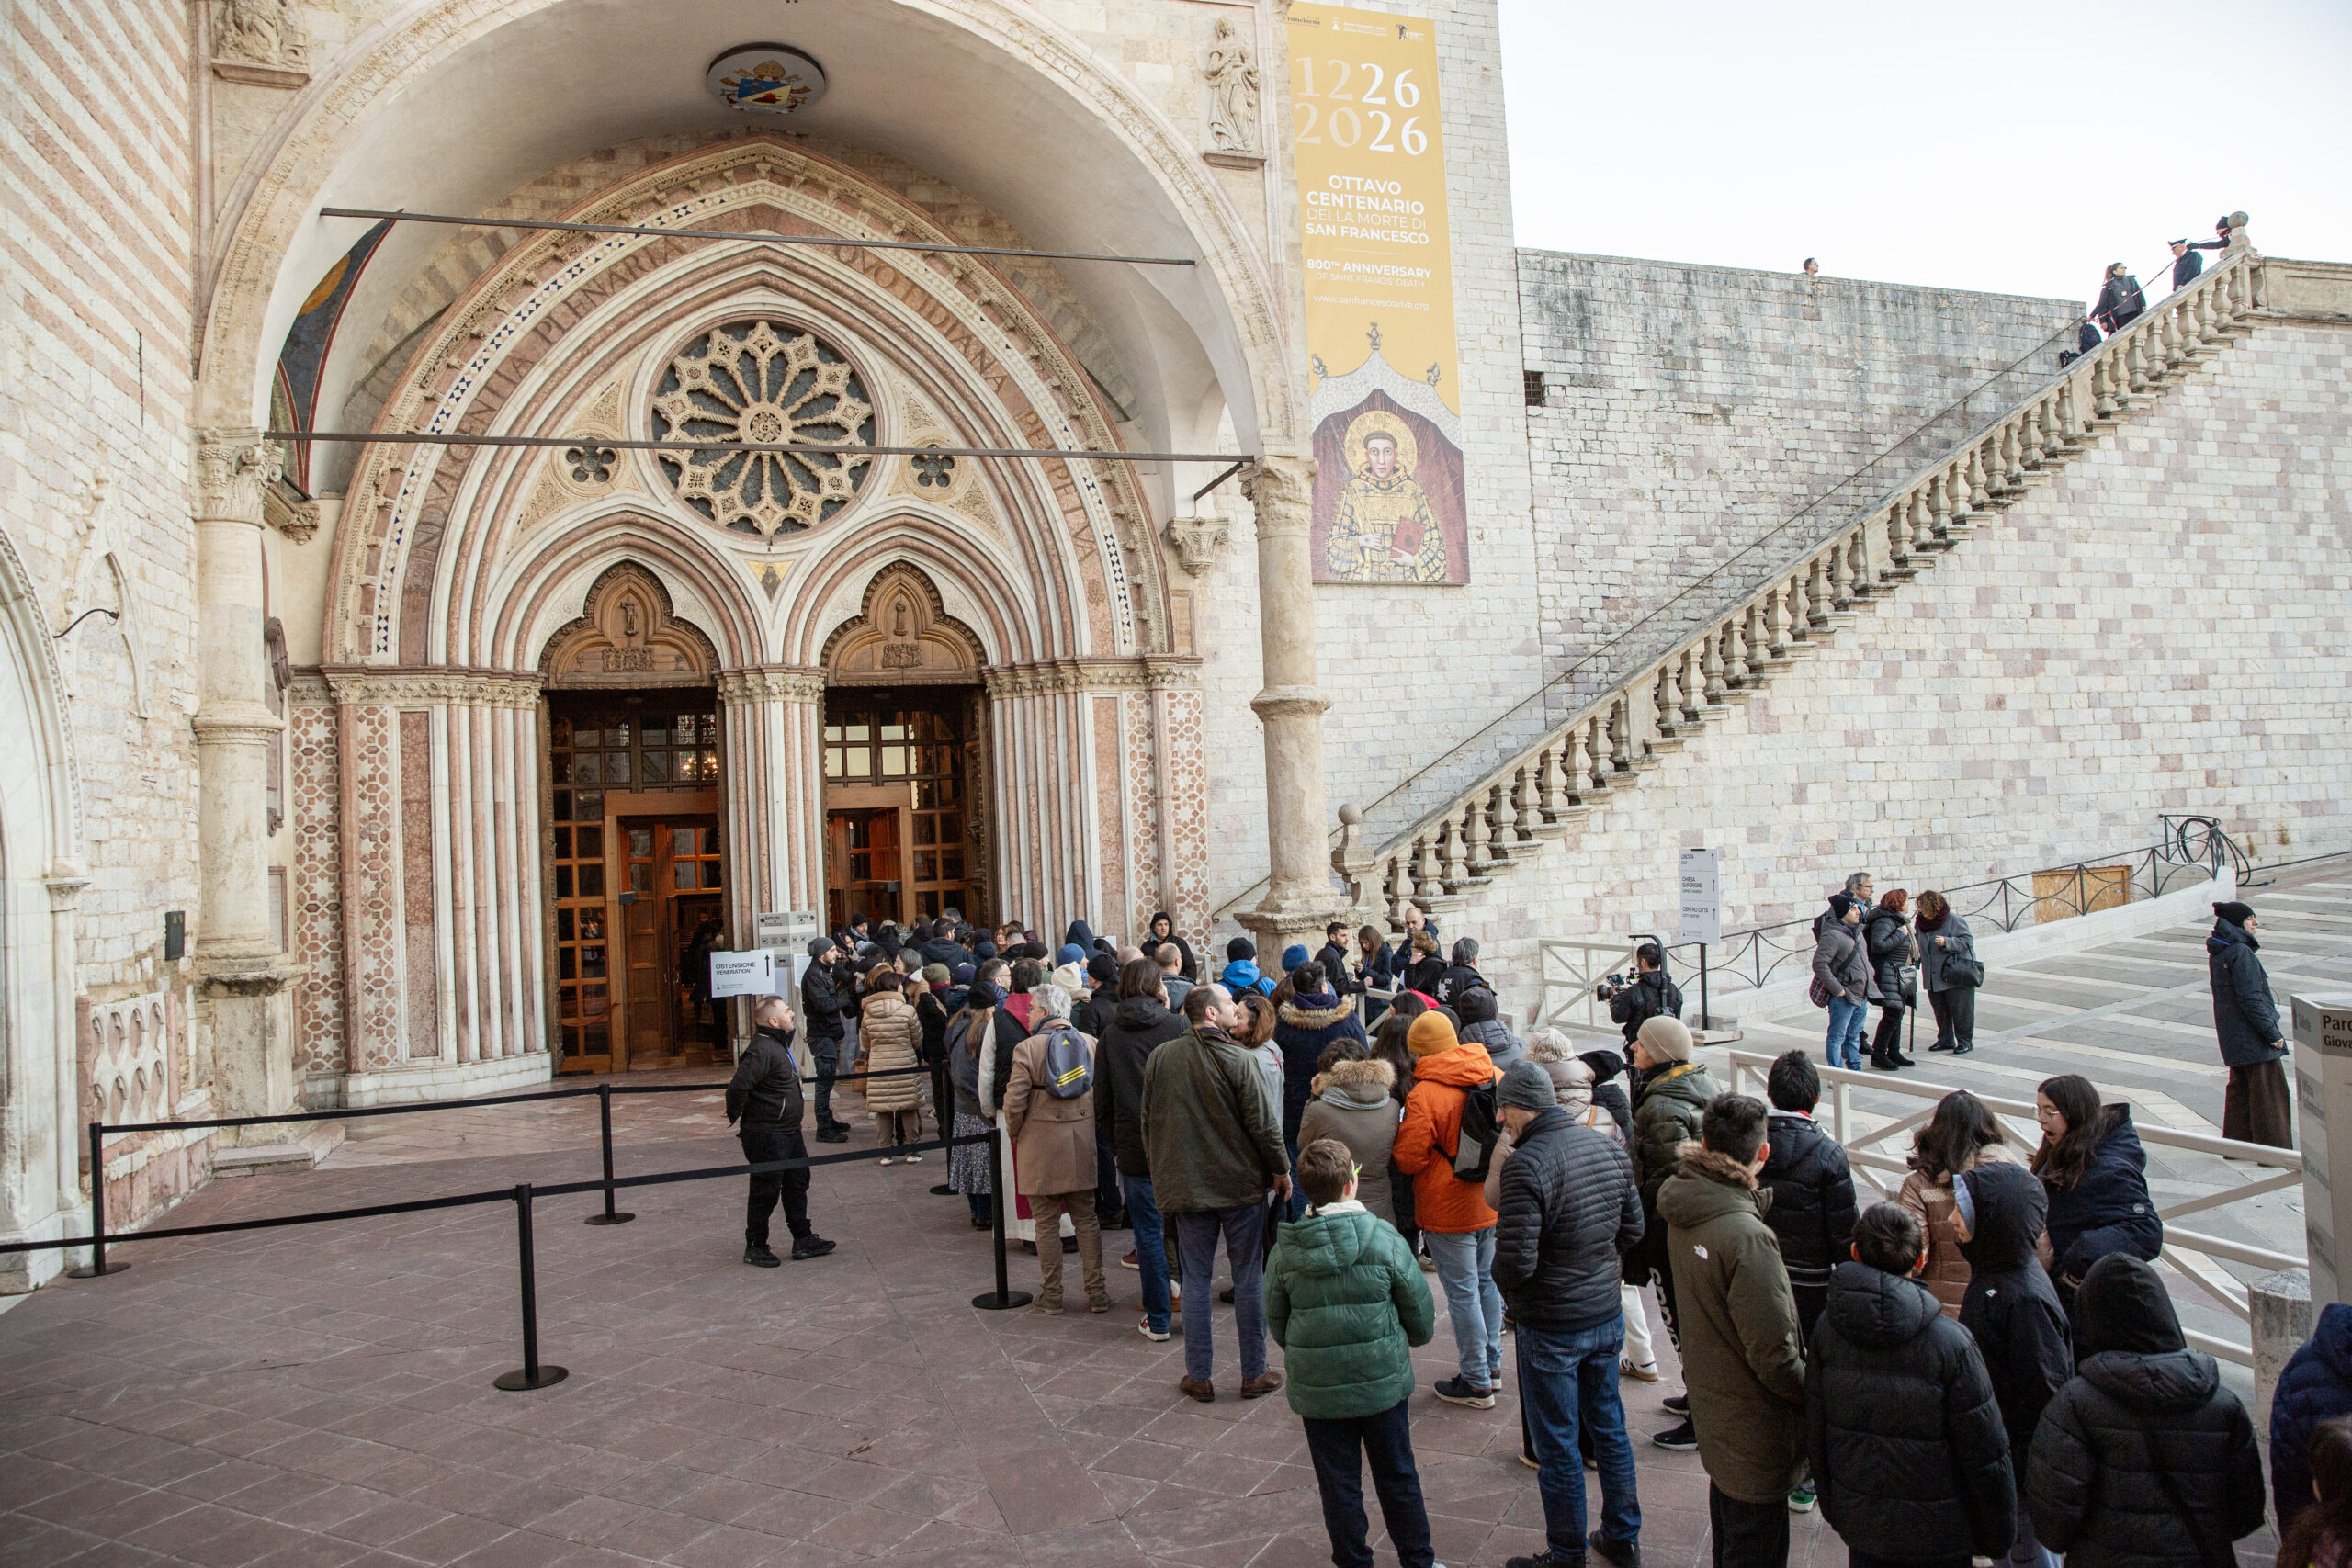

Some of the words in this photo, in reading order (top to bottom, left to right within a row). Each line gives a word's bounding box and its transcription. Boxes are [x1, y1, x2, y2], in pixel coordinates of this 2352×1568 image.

[1295, 56, 1420, 108] 1226
[1294, 102, 1428, 156] 2026
[1329, 175, 1402, 196] OTTAVO
[1306, 190, 1425, 215] CENTENARIO
[1307, 208, 1354, 223] DELLA
[1358, 212, 1408, 229] MORTE
[1412, 217, 1427, 230] DI
[1306, 222, 1337, 236] SAN
[1340, 225, 1430, 244] FRANCESCO
[1316, 272, 1329, 280] OF
[1330, 273, 1355, 282] SAINT
[1396, 278, 1425, 288] DEATH
[1342, 262, 1431, 279] ANNIVERSARY
[1313, 295, 1430, 313] www.sanfrancescovive.org
